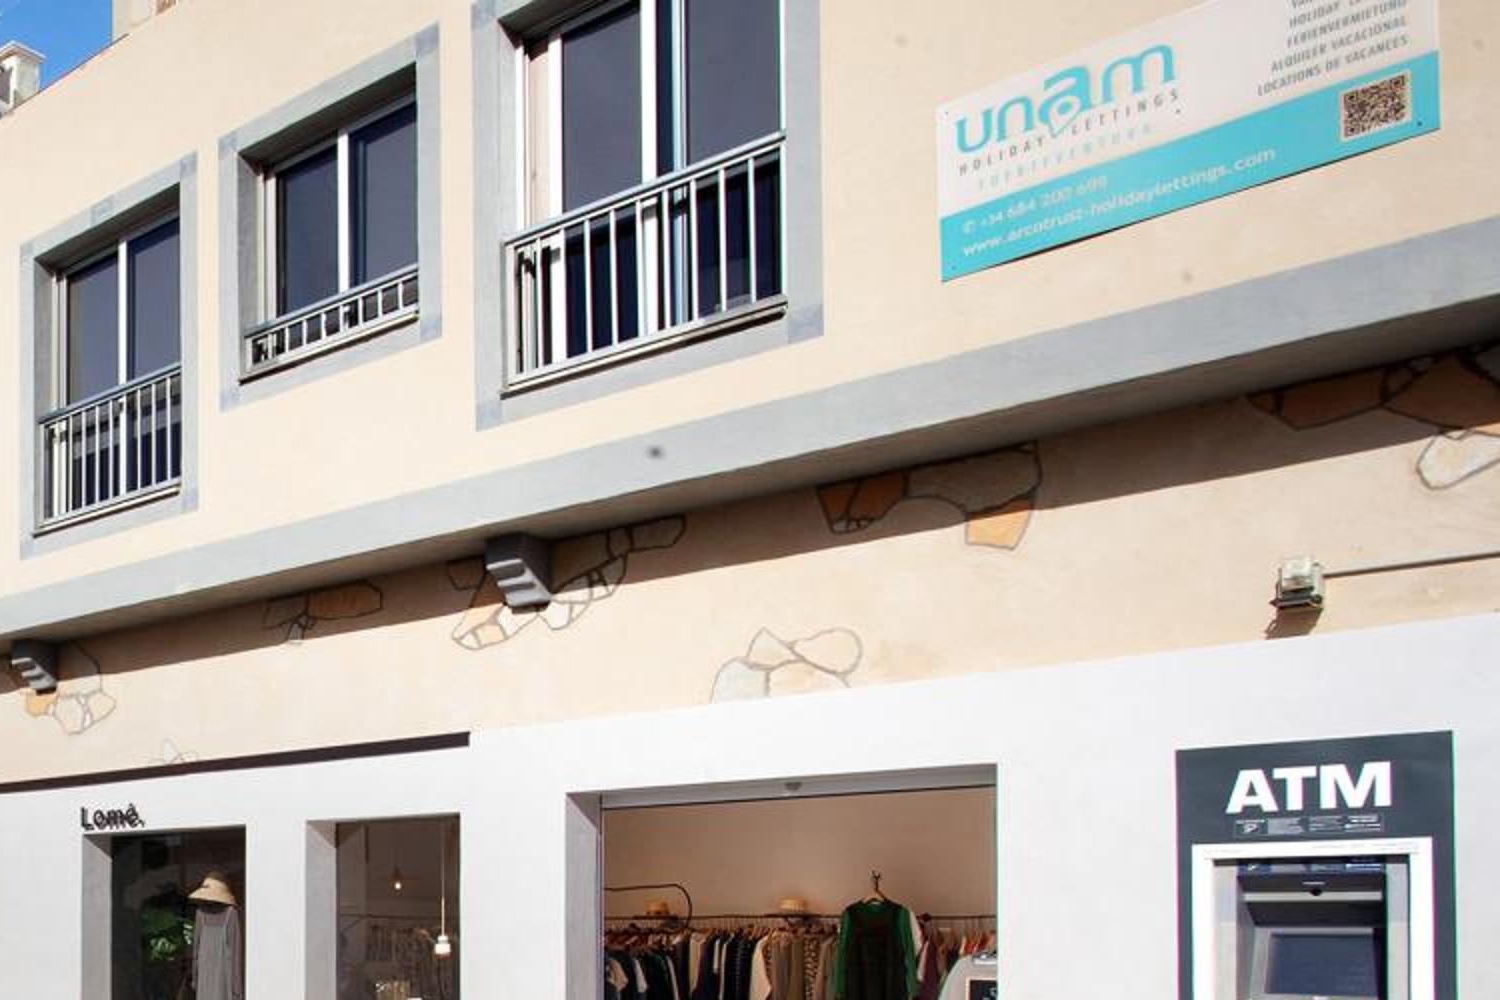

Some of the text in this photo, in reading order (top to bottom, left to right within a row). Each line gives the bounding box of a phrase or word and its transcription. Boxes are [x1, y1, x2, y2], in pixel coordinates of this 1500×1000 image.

[1288, 1, 1340, 29] HOLIDAY
[1256, 63, 1322, 97] LOCATIONS
[1344, 34, 1409, 65] VACANCES
[954, 44, 1177, 154] unam
[958, 87, 1181, 178] HOLIDAY LETTINGS
[1225, 760, 1393, 815] ATM
